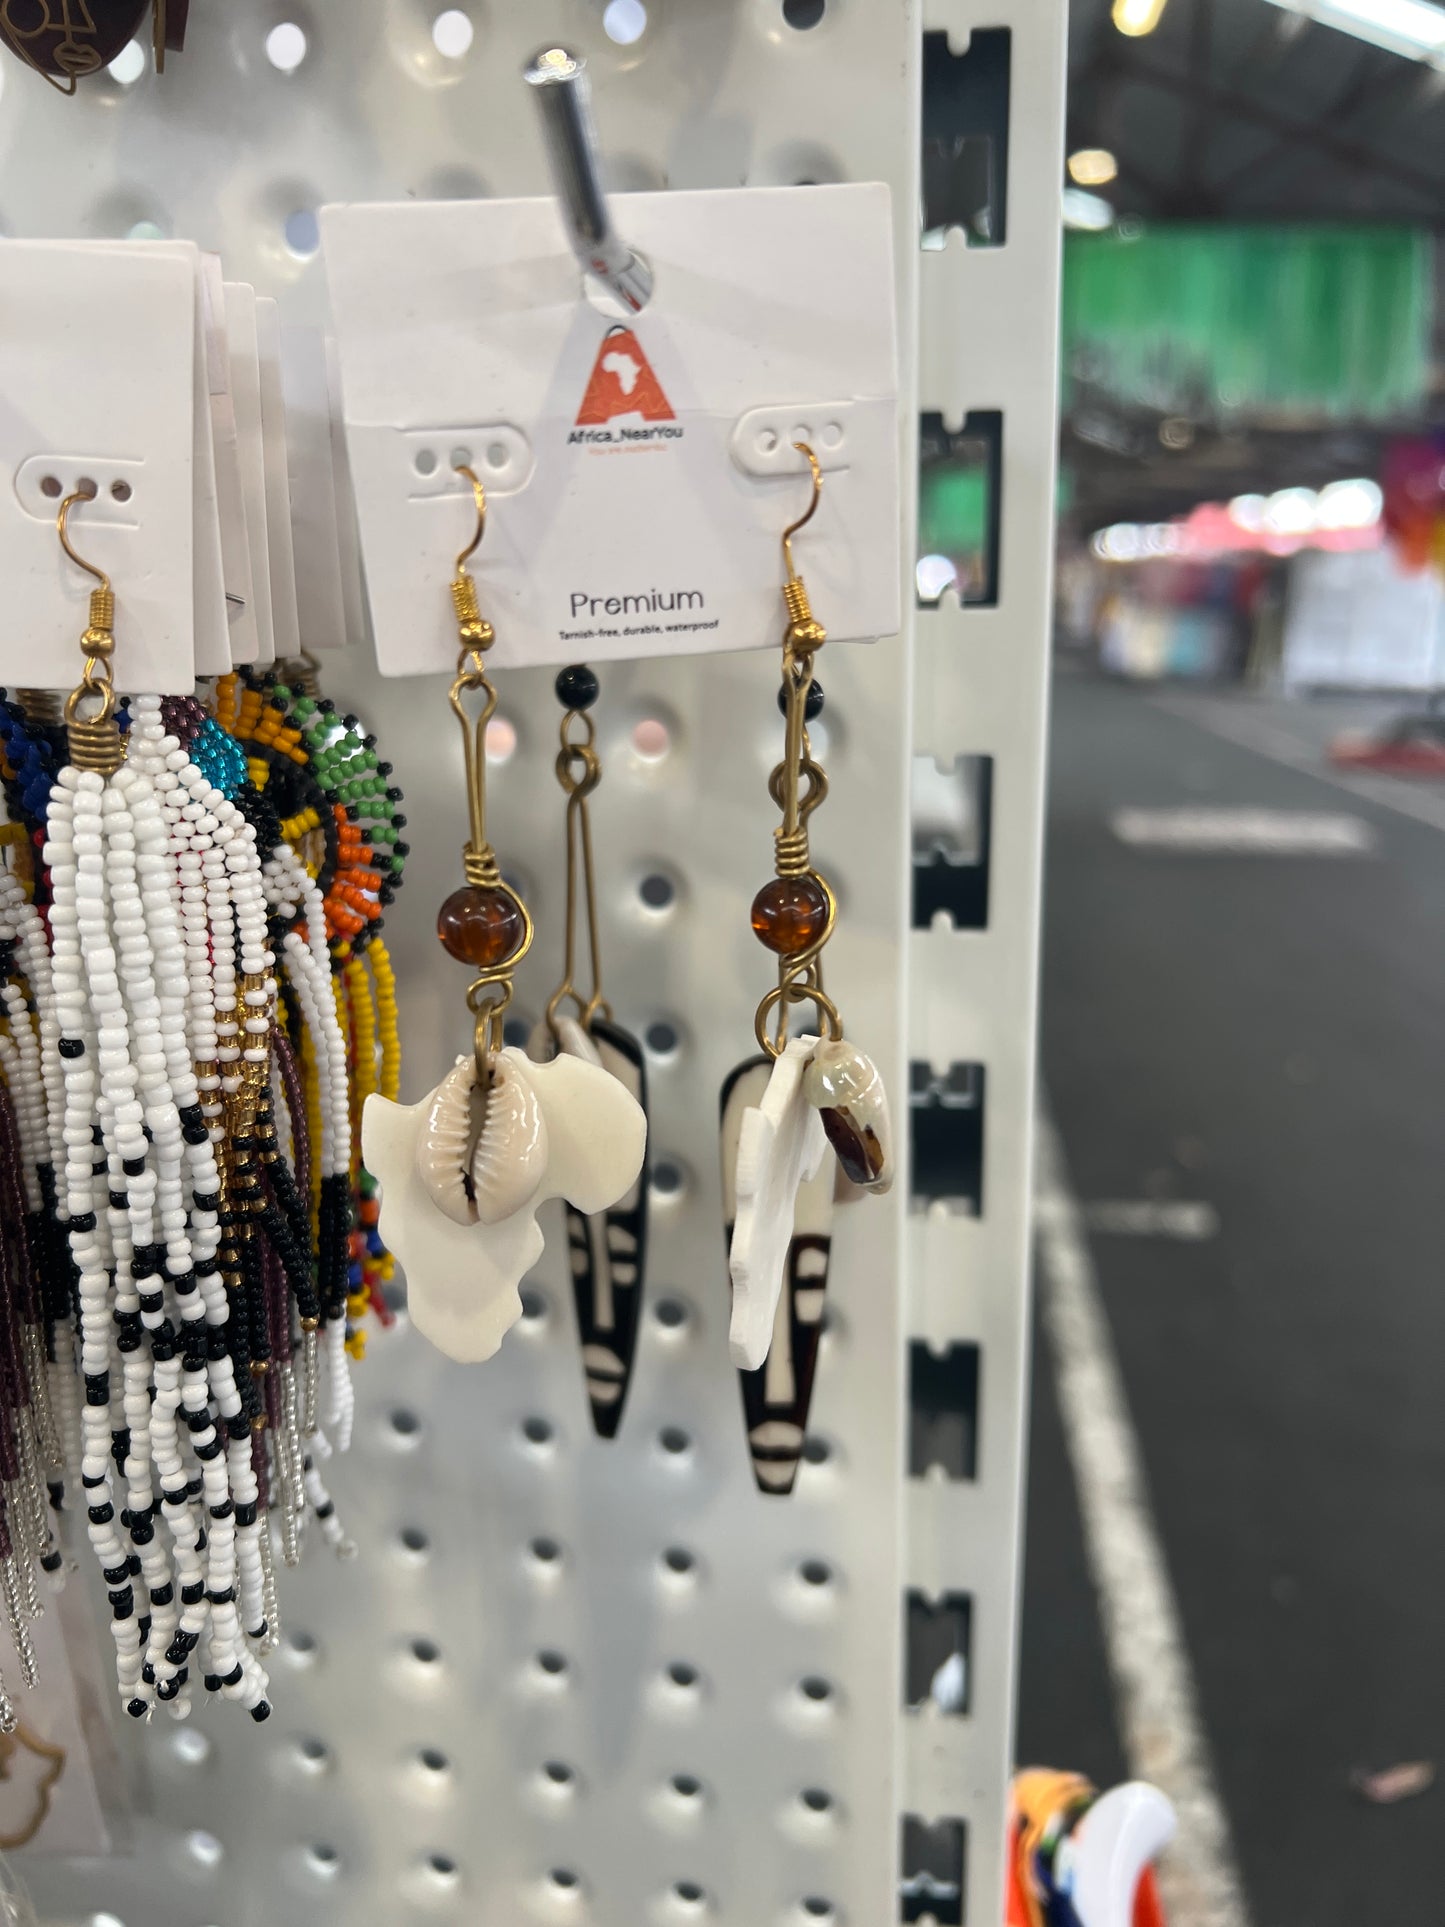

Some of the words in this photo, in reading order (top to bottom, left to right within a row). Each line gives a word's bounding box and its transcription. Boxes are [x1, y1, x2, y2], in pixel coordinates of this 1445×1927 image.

[567, 426, 684, 445] Africa_NearYou
[570, 588, 704, 618] Premium
[559, 628, 621, 640] Tarnish-free,
[623, 625, 663, 636] durable,
[665, 619, 719, 633] waterproof
